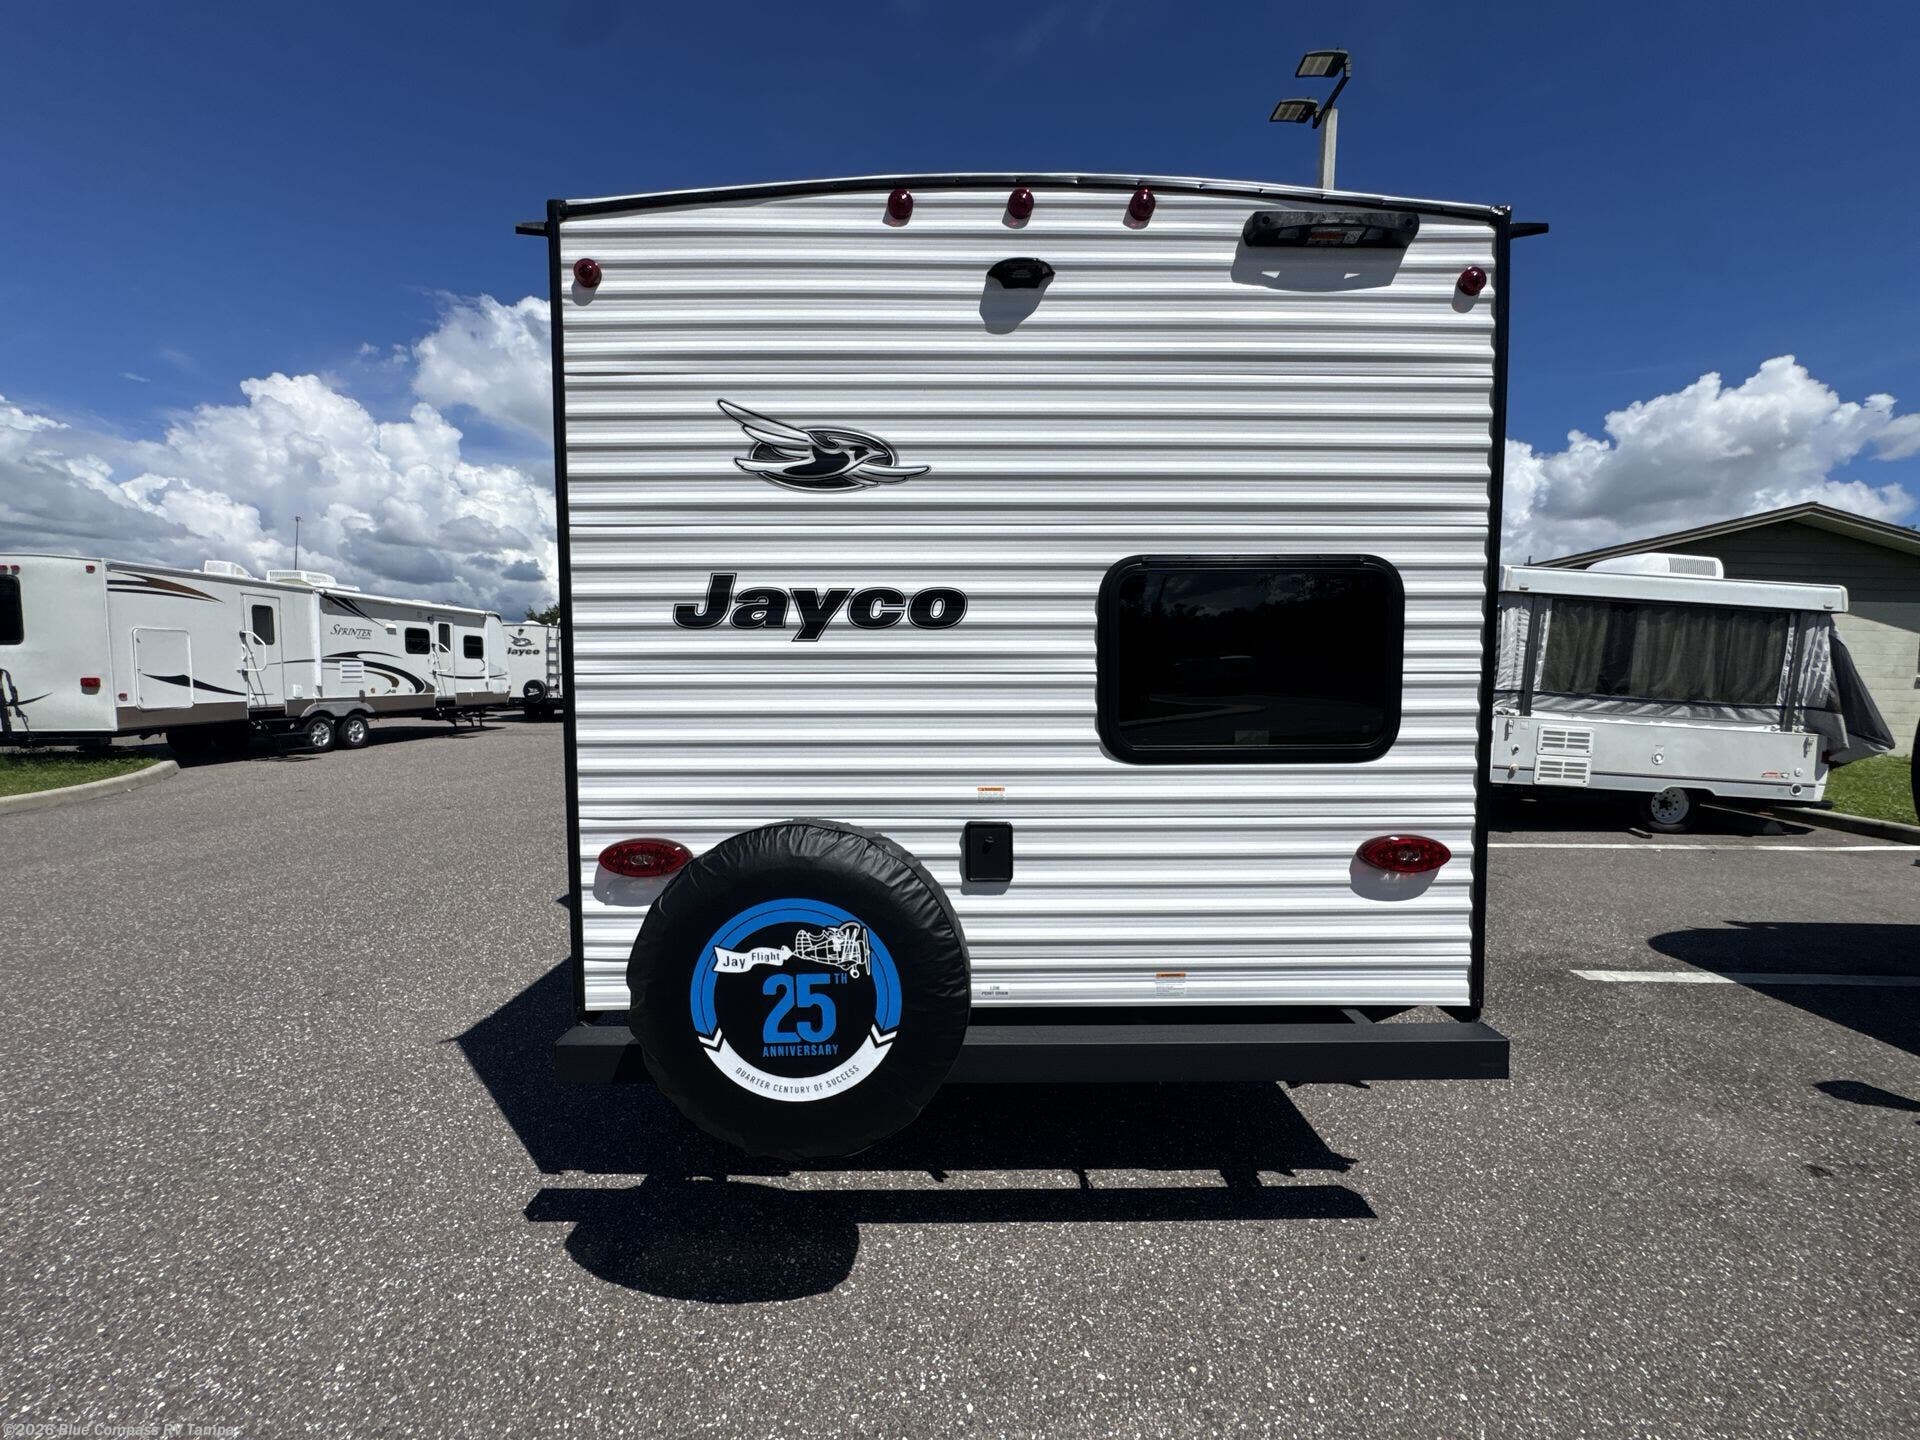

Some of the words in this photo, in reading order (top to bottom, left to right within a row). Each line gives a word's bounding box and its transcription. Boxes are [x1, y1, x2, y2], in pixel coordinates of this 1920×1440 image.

[672, 572, 968, 642] Jayco
[722, 955, 746, 969] Jay
[751, 951, 781, 963] Flight
[762, 1044, 839, 1058] ANNIVERSARY
[735, 1066, 770, 1089] QUARTER
[773, 1083, 811, 1094] CENTURY
[813, 1083, 824, 1092] OF
[826, 1064, 860, 1088] SUCCESS
